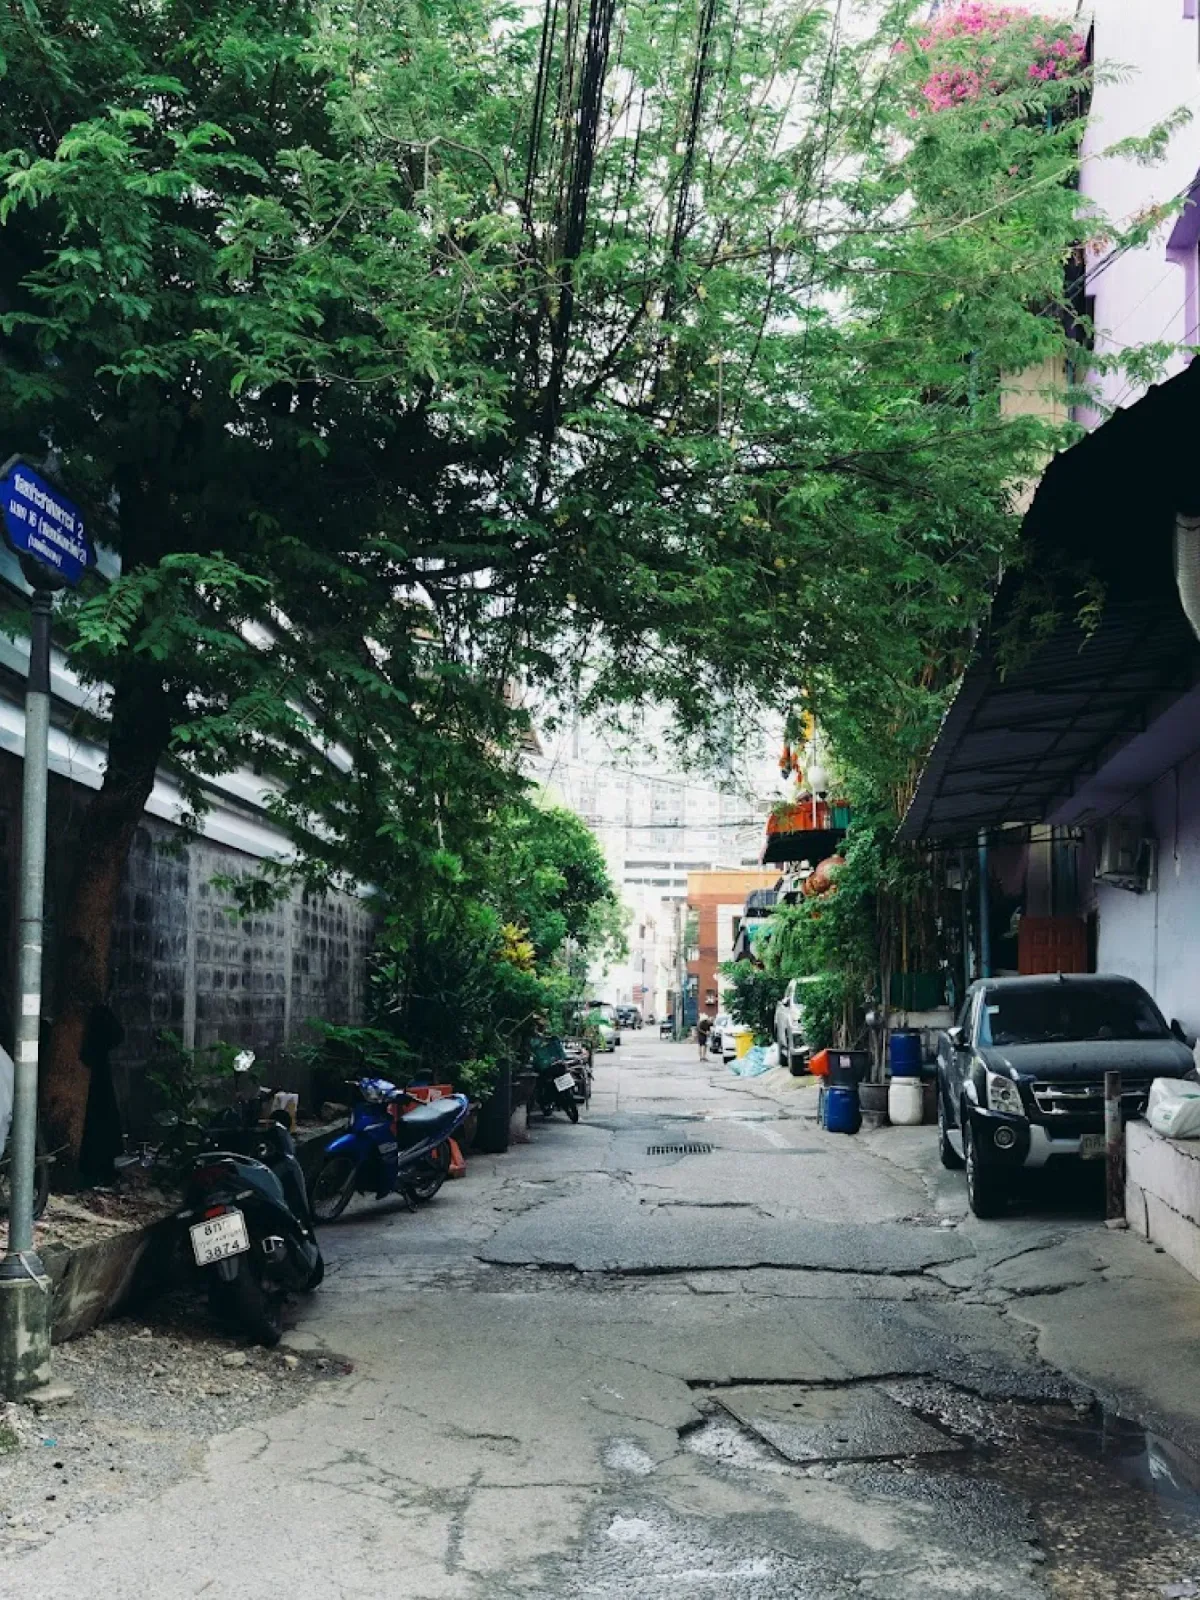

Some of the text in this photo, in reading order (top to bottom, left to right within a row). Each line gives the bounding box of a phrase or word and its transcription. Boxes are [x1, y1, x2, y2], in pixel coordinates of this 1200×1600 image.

[28, 509, 37, 527] 16
[77, 522, 84, 540] 2
[205, 1240, 239, 1260] 3874
